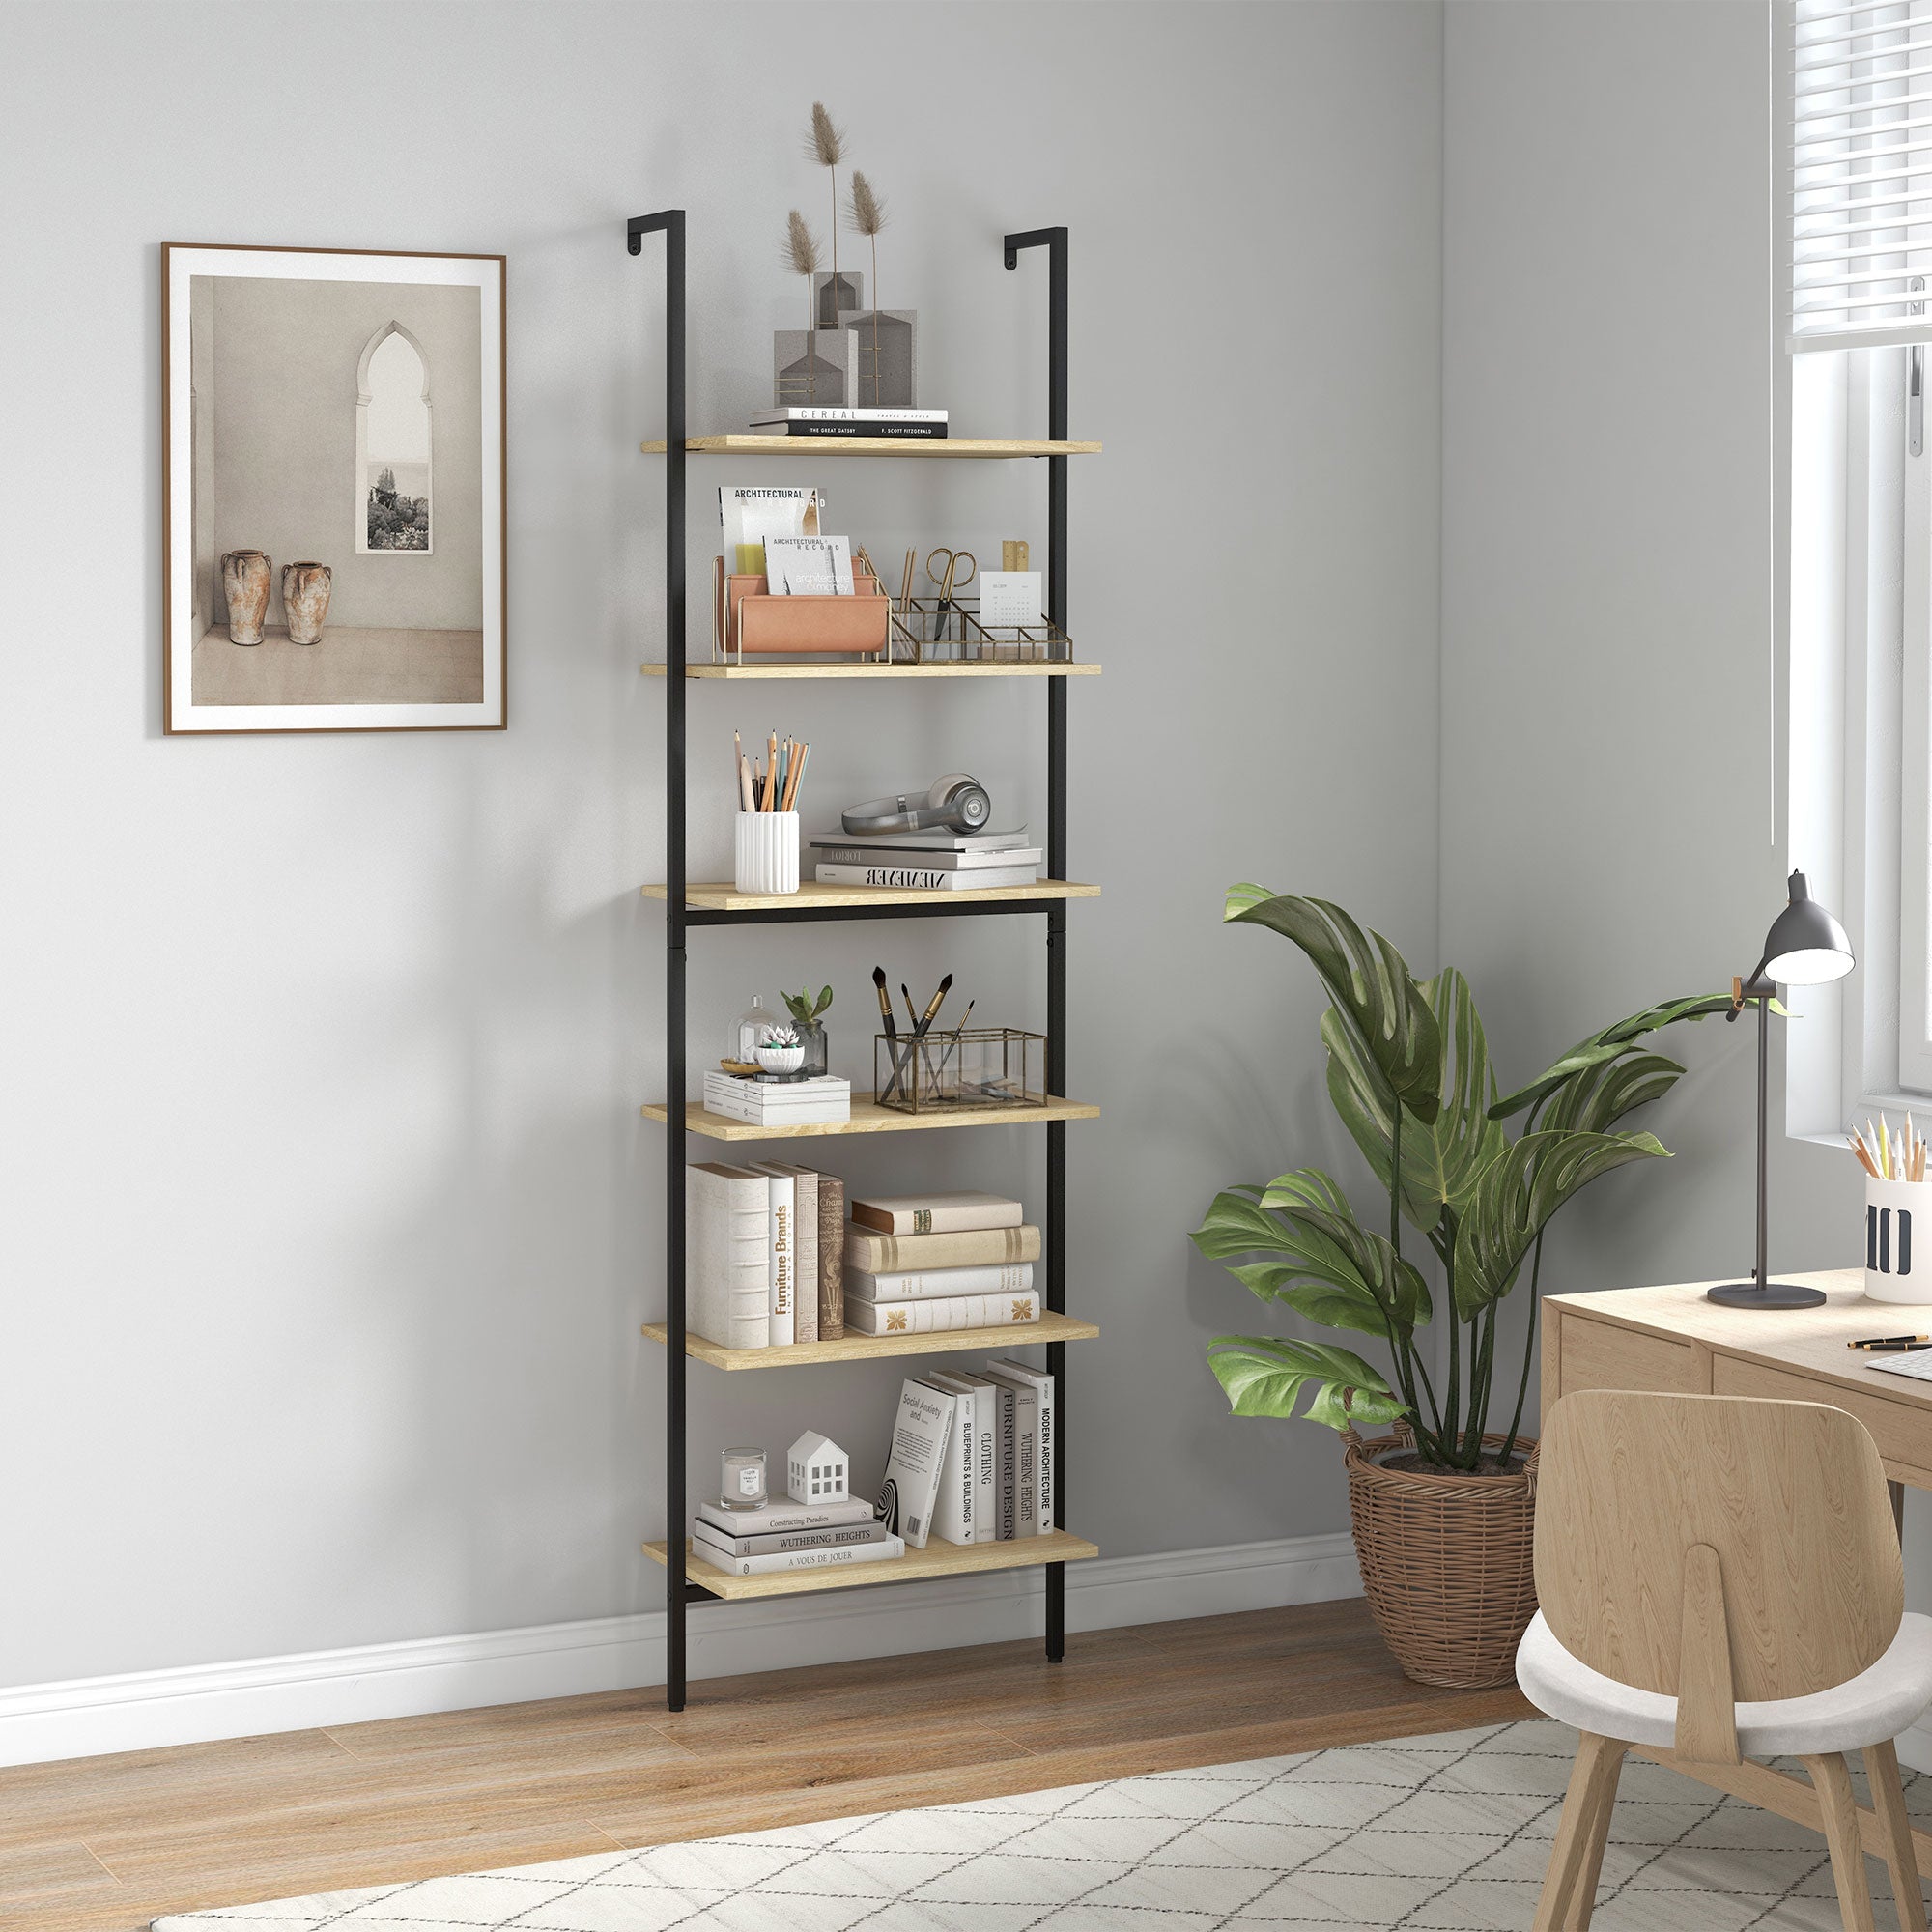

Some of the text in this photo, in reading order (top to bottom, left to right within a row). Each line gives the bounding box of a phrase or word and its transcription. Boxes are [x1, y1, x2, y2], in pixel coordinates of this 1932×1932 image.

[801, 410, 856, 419] CEREAL
[734, 489, 805, 498] ARCHITECTURAL
[795, 570, 851, 582] architecture
[775, 1205, 786, 1315] Furniture Brands
[903, 1393, 942, 1420] Social Anxiety
[909, 1409, 922, 1421] and
[1041, 1407, 1050, 1444] MODERN
[963, 1422, 972, 1472] BLUEPRINTS
[980, 1432, 992, 1485] CLOTHING
[1003, 1394, 1013, 1540] FURNITURE DESIGN
[1020, 1433, 1033, 1521] WUTHERING HEIGHTS
[1041, 1446, 1050, 1509] ARCHITECTURE
[963, 1481, 972, 1523] BUILDINGS
[770, 1519, 806, 1527] Constructing
[780, 1529, 871, 1548] WUTHERING HEIGHTS
[796, 1555, 816, 1565] VOUS
[817, 1554, 828, 1563] DE
[829, 1551, 853, 1564] JOUER
